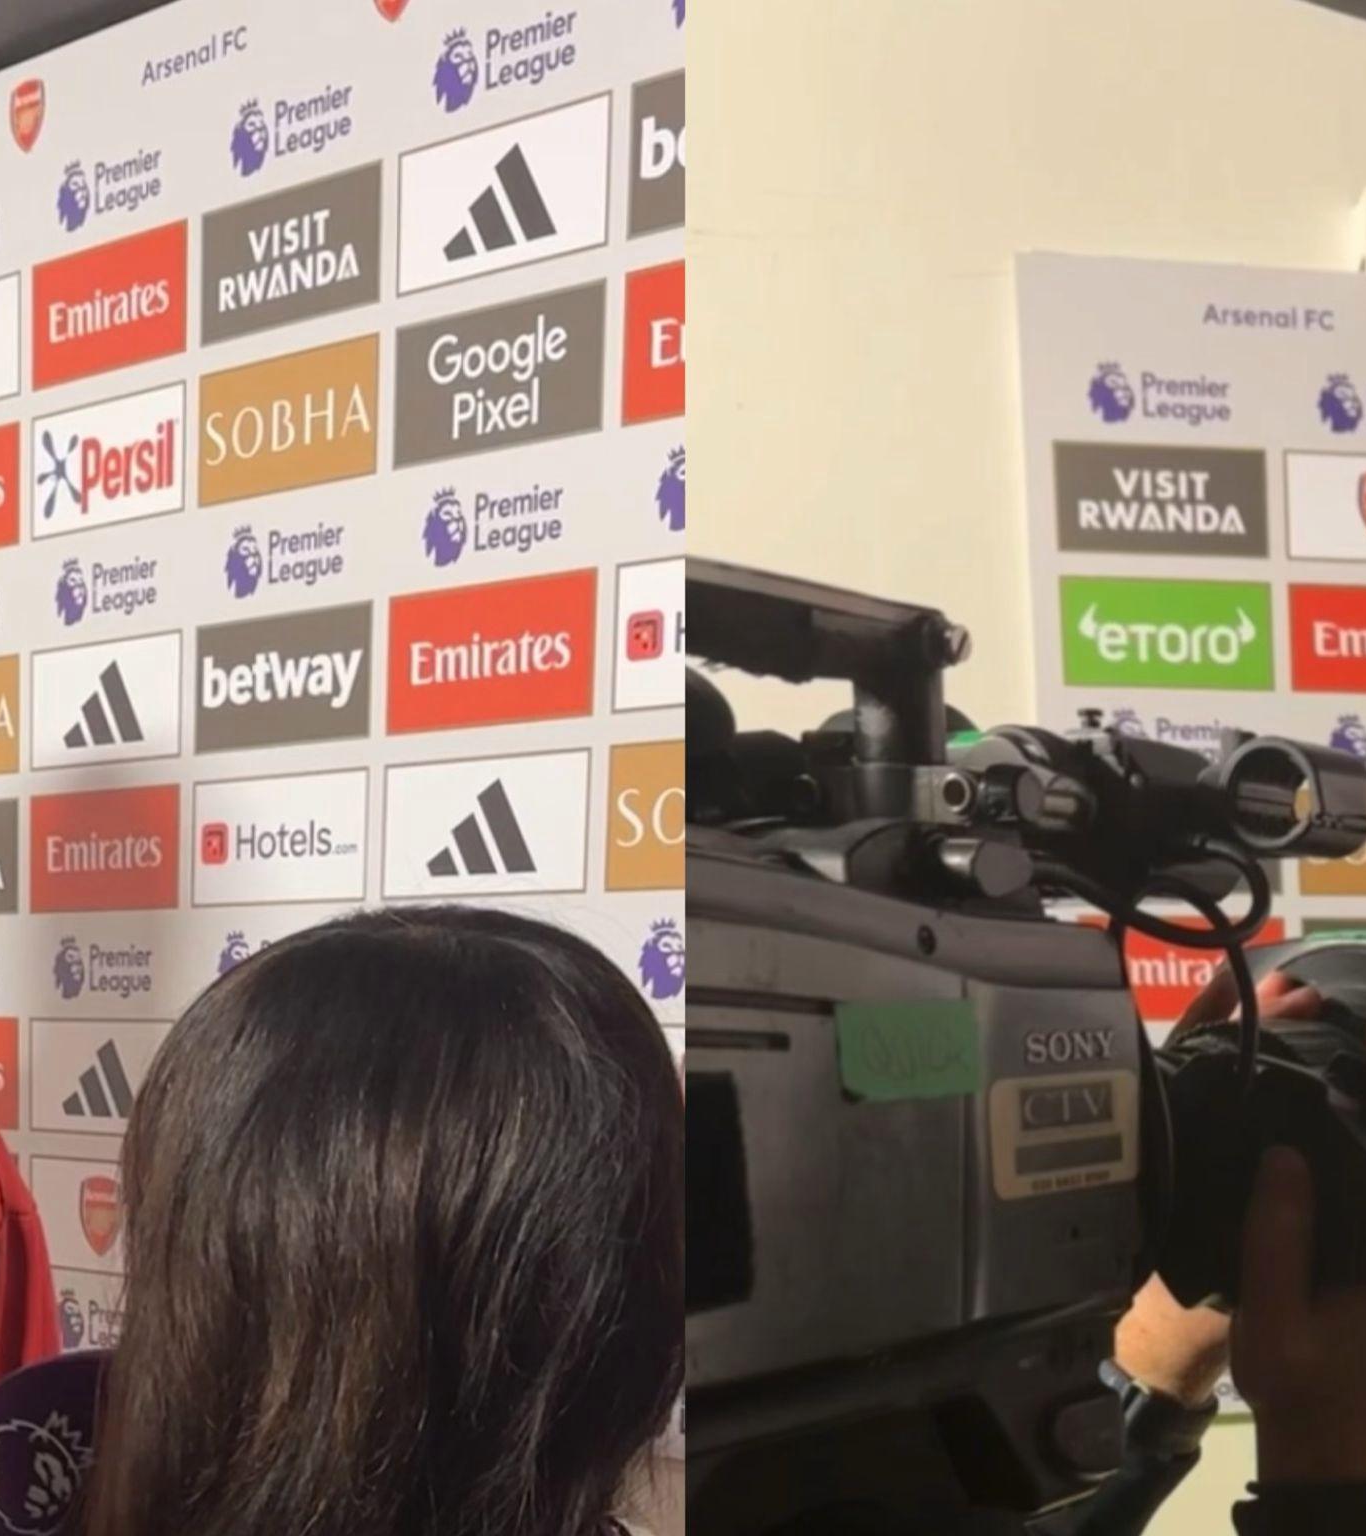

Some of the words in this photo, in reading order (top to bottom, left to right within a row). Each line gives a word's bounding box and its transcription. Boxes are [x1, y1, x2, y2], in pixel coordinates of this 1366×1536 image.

[484, 10, 577, 58] Premier
[142, 34, 217, 86] Arsenal
[223, 26, 249, 57] FC
[485, 42, 577, 91] League
[273, 83, 352, 126] Premier
[273, 116, 353, 157] League
[94, 148, 162, 185] Premier
[94, 177, 162, 214] League
[248, 209, 330, 264] VISIT
[218, 244, 360, 313] RWANDA
[48, 278, 170, 345] Emirates
[1202, 303, 1297, 330] Arsenal
[1304, 310, 1335, 332] FC
[427, 314, 568, 386] Google
[1141, 371, 1230, 398] Premier
[203, 382, 372, 466] SOBHA
[451, 378, 540, 440] Pixel
[1142, 396, 1231, 427] League
[81, 418, 175, 515] Persil
[1113, 467, 1209, 500] VISIT
[473, 485, 563, 521] Premier
[1078, 499, 1246, 535] RWANDA
[268, 522, 344, 556] Premier
[473, 516, 562, 554] League
[92, 556, 157, 587] Premier
[268, 553, 343, 586] League
[92, 584, 157, 615] League
[409, 631, 571, 687] Emirates
[202, 649, 364, 709] betway
[46, 832, 163, 873] Emirates
[89, 944, 152, 970] Premier
[89, 967, 152, 998] League
[1024, 1030, 1114, 1065] SONY
